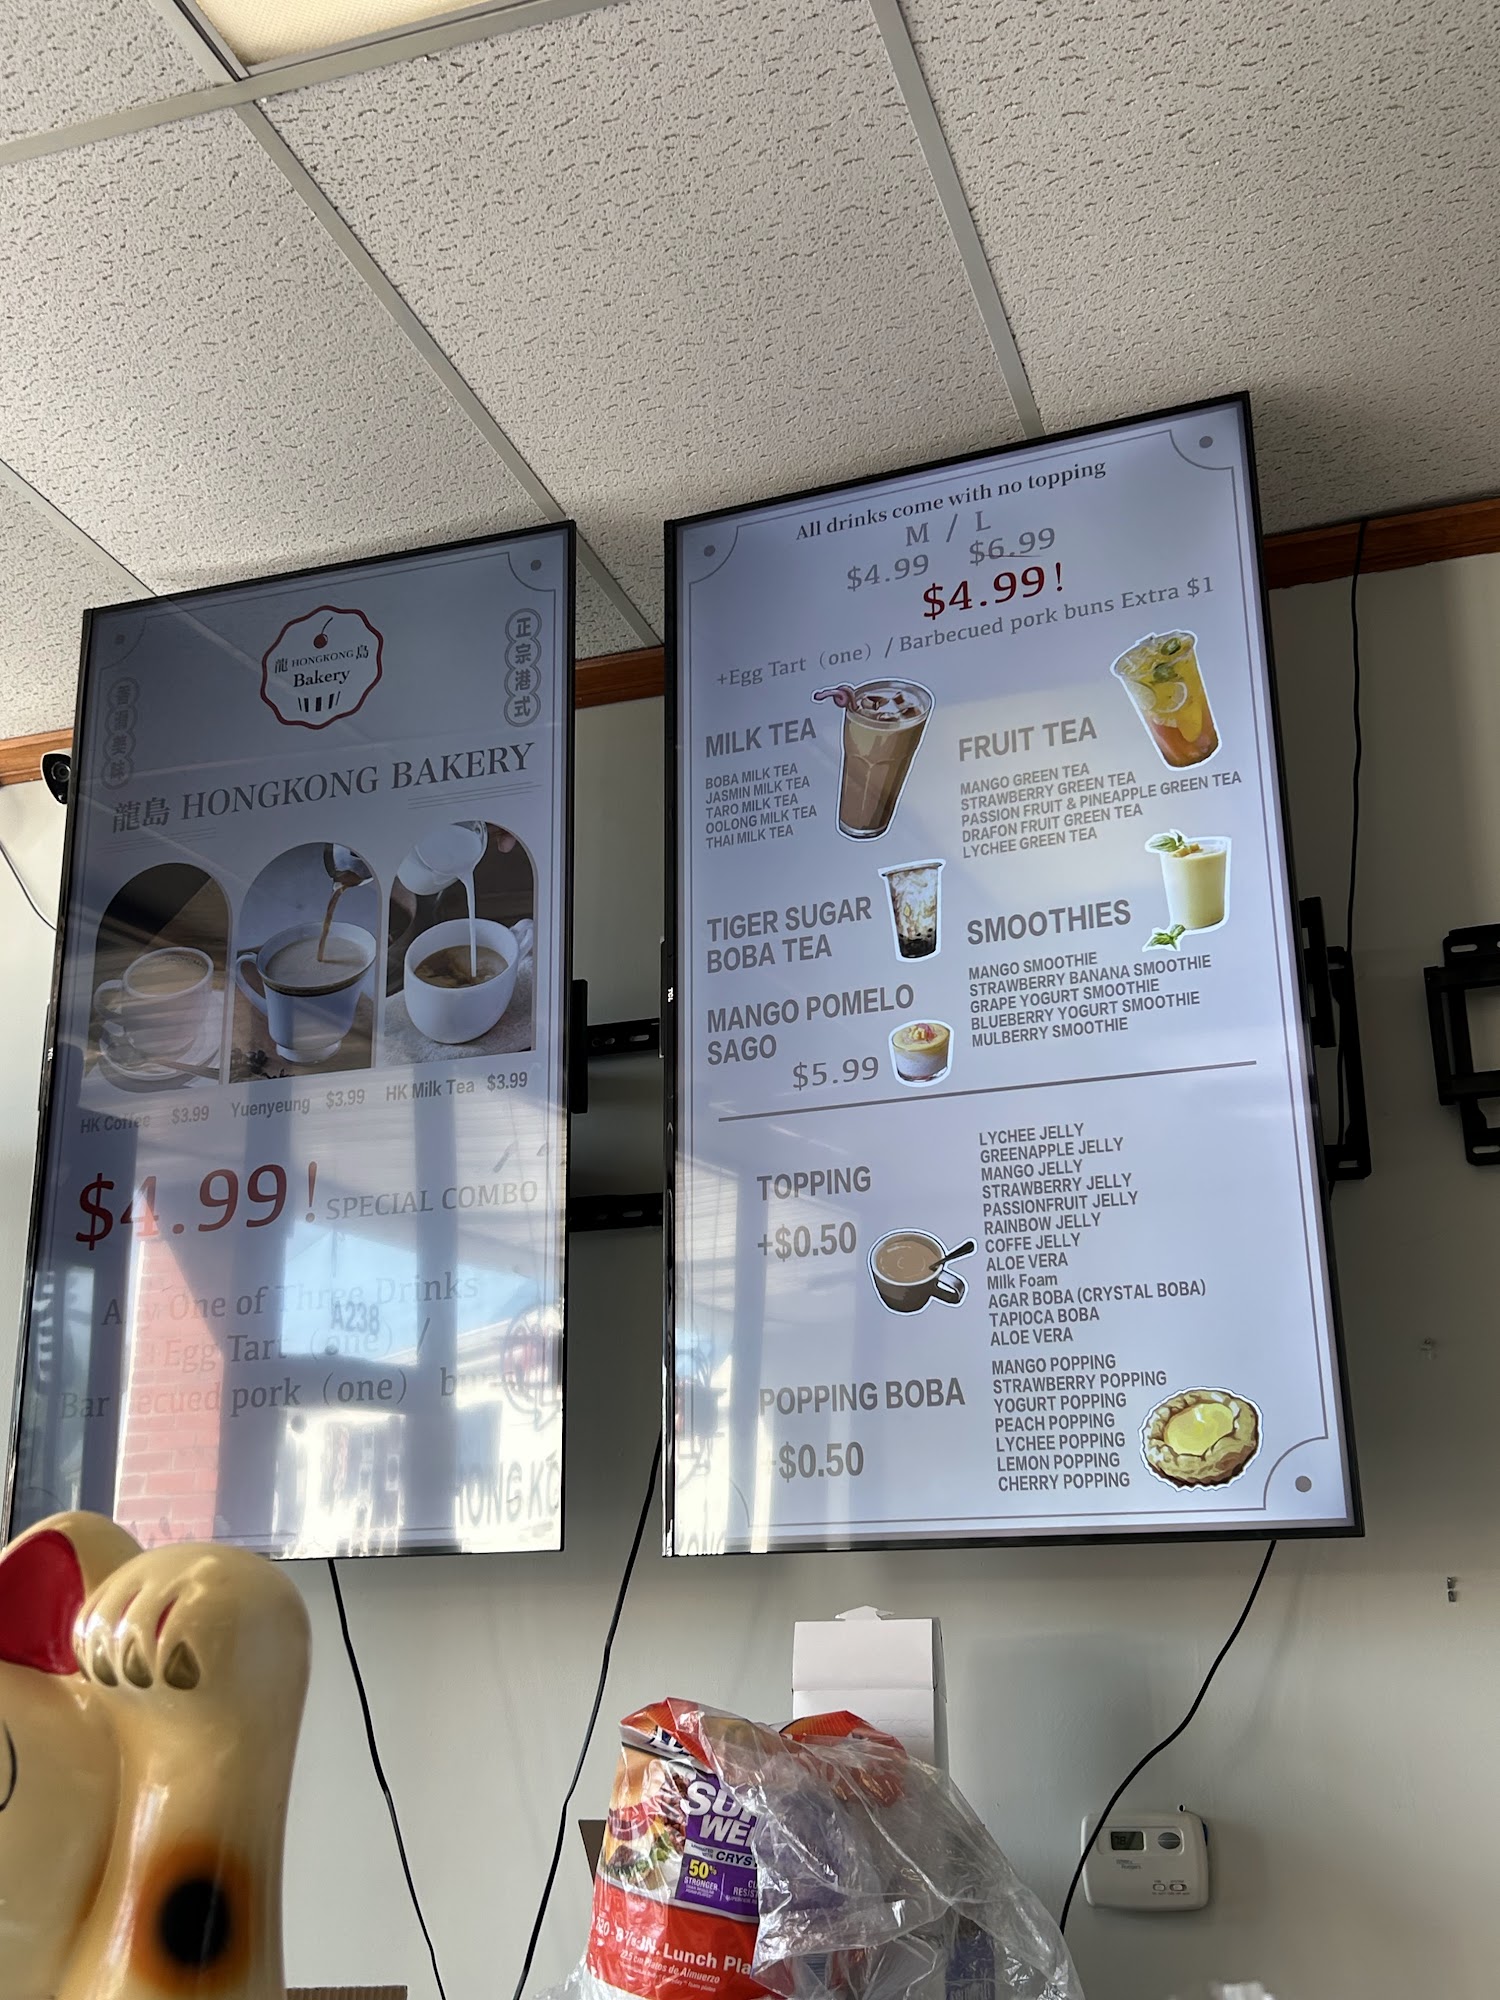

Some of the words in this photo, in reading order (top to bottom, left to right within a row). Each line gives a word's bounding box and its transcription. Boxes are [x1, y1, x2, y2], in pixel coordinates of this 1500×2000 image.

[796, 520, 821, 540] All
[826, 509, 887, 533] drinks
[892, 498, 944, 518] come
[948, 484, 992, 506] with
[998, 481, 1022, 496] no
[1028, 462, 1106, 490] topping
[906, 522, 930, 547] M
[975, 510, 991, 532] L
[847, 554, 929, 591] $4.99
[969, 528, 1055, 566] $6.99
[923, 562, 1063, 621] $4.99!
[717, 668, 763, 687] +Egg
[768, 658, 806, 677] Tart
[900, 616, 1004, 652] Barbecued
[1010, 607, 1058, 635] pork
[1063, 599, 1115, 620] buns
[1121, 587, 1180, 609] Extra
[1187, 576, 1214, 598] $1
[291, 650, 354, 667] HONGKONG
[513, 616, 532, 718] 正宗港式
[293, 669, 350, 688] Bakery
[706, 726, 762, 758] MILK
[768, 717, 817, 746] TEA
[959, 726, 1035, 762] FRUIT
[1042, 716, 1097, 747] TEA
[181, 766, 379, 821] HONGKONG
[391, 742, 535, 790] BAKERY
[705, 773, 739, 790] BOBA
[741, 767, 771, 784] MILK
[773, 762, 798, 778] TEA
[705, 785, 751, 805] JASMIN
[753, 779, 783, 797] MILK
[785, 776, 810, 791] TEA
[960, 776, 1010, 795] MANGO
[1012, 767, 1059, 787] GREEN
[1062, 762, 1090, 778] TEA
[705, 803, 740, 819] TARO
[741, 796, 771, 814] MILK
[773, 792, 798, 808] TEA
[961, 783, 1055, 811] STRAWBERRY
[1057, 776, 1105, 796] GREEN
[1107, 771, 1136, 788] TEA
[962, 806, 1020, 827] PASSION
[1023, 798, 1063, 817] FRUIT
[1066, 797, 1077, 810] &
[1080, 784, 1157, 808] PINEAPPLE
[1160, 775, 1208, 795] GREEN
[1211, 771, 1242, 787] TEA
[705, 814, 757, 834] OOLONG
[760, 809, 789, 826] MILK
[792, 804, 817, 820] TEA
[962, 822, 1018, 843] DRAFON
[1020, 815, 1060, 834] FRUIT
[1063, 807, 1111, 827] GREEN
[1113, 803, 1143, 819] TEA
[705, 833, 734, 849] THAI
[737, 828, 766, 844] MILK
[768, 824, 794, 839] TEA
[963, 838, 1017, 859] LYCHEE
[1019, 830, 1066, 850] GREEN
[1068, 826, 1098, 842] TEA
[707, 910, 779, 942] TIGER
[785, 896, 872, 931] SUGAR
[967, 899, 1131, 945] SMOOTHIES
[707, 942, 776, 974] BOBA
[782, 933, 832, 962] TEA
[969, 962, 1020, 980] MANGO
[1023, 952, 1098, 974] SMOOTHIE
[970, 972, 1066, 997] STRAWBERRY
[1069, 965, 1131, 985] BANANA
[1133, 954, 1211, 977] SMOOTHIE
[707, 999, 799, 1033] MANGO
[806, 984, 914, 1021] POMELO
[970, 995, 1017, 1014] GRAPE
[1019, 988, 1079, 1007] YOGURT
[1083, 978, 1160, 1000] SMOOTHIE
[971, 1008, 1054, 1030] BLUEBERRY
[1057, 1000, 1118, 1020] YOGURT
[1122, 991, 1200, 1013] SMOOTHIE
[972, 1026, 1049, 1047] MULBERRY
[1052, 1016, 1128, 1038] SMOOTHIE
[707, 1034, 777, 1065] SAGO
[486, 1072, 528, 1092] $3.99
[793, 1056, 879, 1091] $5.99
[325, 1088, 366, 1111] $3.99
[386, 1084, 409, 1102] HK
[411, 1079, 442, 1100] Milk
[447, 1077, 475, 1096] Tea
[171, 1106, 210, 1126] $3.99
[230, 1096, 311, 1120] Yuenyeung
[80, 1119, 101, 1134] HK
[103, 1112, 151, 1131] Coffee
[979, 1127, 1037, 1146] LYCHEE
[1039, 1122, 1084, 1141] JELLY
[980, 1142, 1074, 1164] GREENAPPLE
[1078, 1137, 1123, 1155] JELLY
[756, 1166, 871, 1201] TOPPING
[981, 1163, 1034, 1181] MANGO
[1038, 1158, 1083, 1176] JELLY
[982, 1176, 1082, 1199] STRAWBERRY
[1086, 1172, 1132, 1190] JELLY
[75, 1162, 318, 1251] $4.99!
[325, 1188, 434, 1221] SPECIAL
[441, 1181, 538, 1210] COMBO
[983, 1195, 1088, 1217] PASSIONFRUIT
[1092, 1191, 1138, 1208] JELLY
[984, 1216, 1052, 1236] RAINBOW
[1055, 1212, 1101, 1230] JELLY
[757, 1221, 857, 1262] +$0.50
[985, 1236, 1032, 1254] COFFE
[1035, 1232, 1080, 1250] JELLY
[986, 1255, 1025, 1272] ALOE
[1027, 1252, 1068, 1268] VERA
[988, 1292, 1029, 1309] AGAR
[1032, 1289, 1074, 1306] BOBA
[1077, 1284, 1154, 1305] (CRYSTAL
[1157, 1279, 1206, 1298] BOBA)
[1019, 1273, 1058, 1288] Foam
[989, 1309, 1055, 1327] TAPIOCA
[1058, 1306, 1100, 1323] BOBA
[227, 1333, 287, 1363] Tart
[990, 1329, 1030, 1346] ALOE
[1032, 1327, 1074, 1344] VERA
[992, 1358, 1046, 1375] MANGO
[1050, 1354, 1116, 1372] POPPING
[760, 1382, 878, 1415] POPPING
[886, 1377, 966, 1409] BOBA
[993, 1374, 1096, 1394] STRAWBERRY
[1100, 1370, 1167, 1389] POPPING
[231, 1377, 302, 1418] pork
[994, 1396, 1056, 1414] YOGURT
[1060, 1392, 1127, 1411] POPPING
[995, 1416, 1045, 1433] PEACH
[1048, 1412, 1115, 1430] POPPING
[996, 1434, 1056, 1452] LYCHEE
[1059, 1432, 1126, 1450] POPPING
[997, 1454, 1050, 1472] LEMON
[1053, 1452, 1120, 1470] POPPING
[998, 1474, 1059, 1492] CHERRY
[1063, 1471, 1130, 1490] POPPING
[684, 1876, 719, 1892] STRONGER
[663, 1942, 717, 1969] Lunch
[668, 1964, 679, 1976] de
[680, 1967, 720, 1984] Almuerzo
